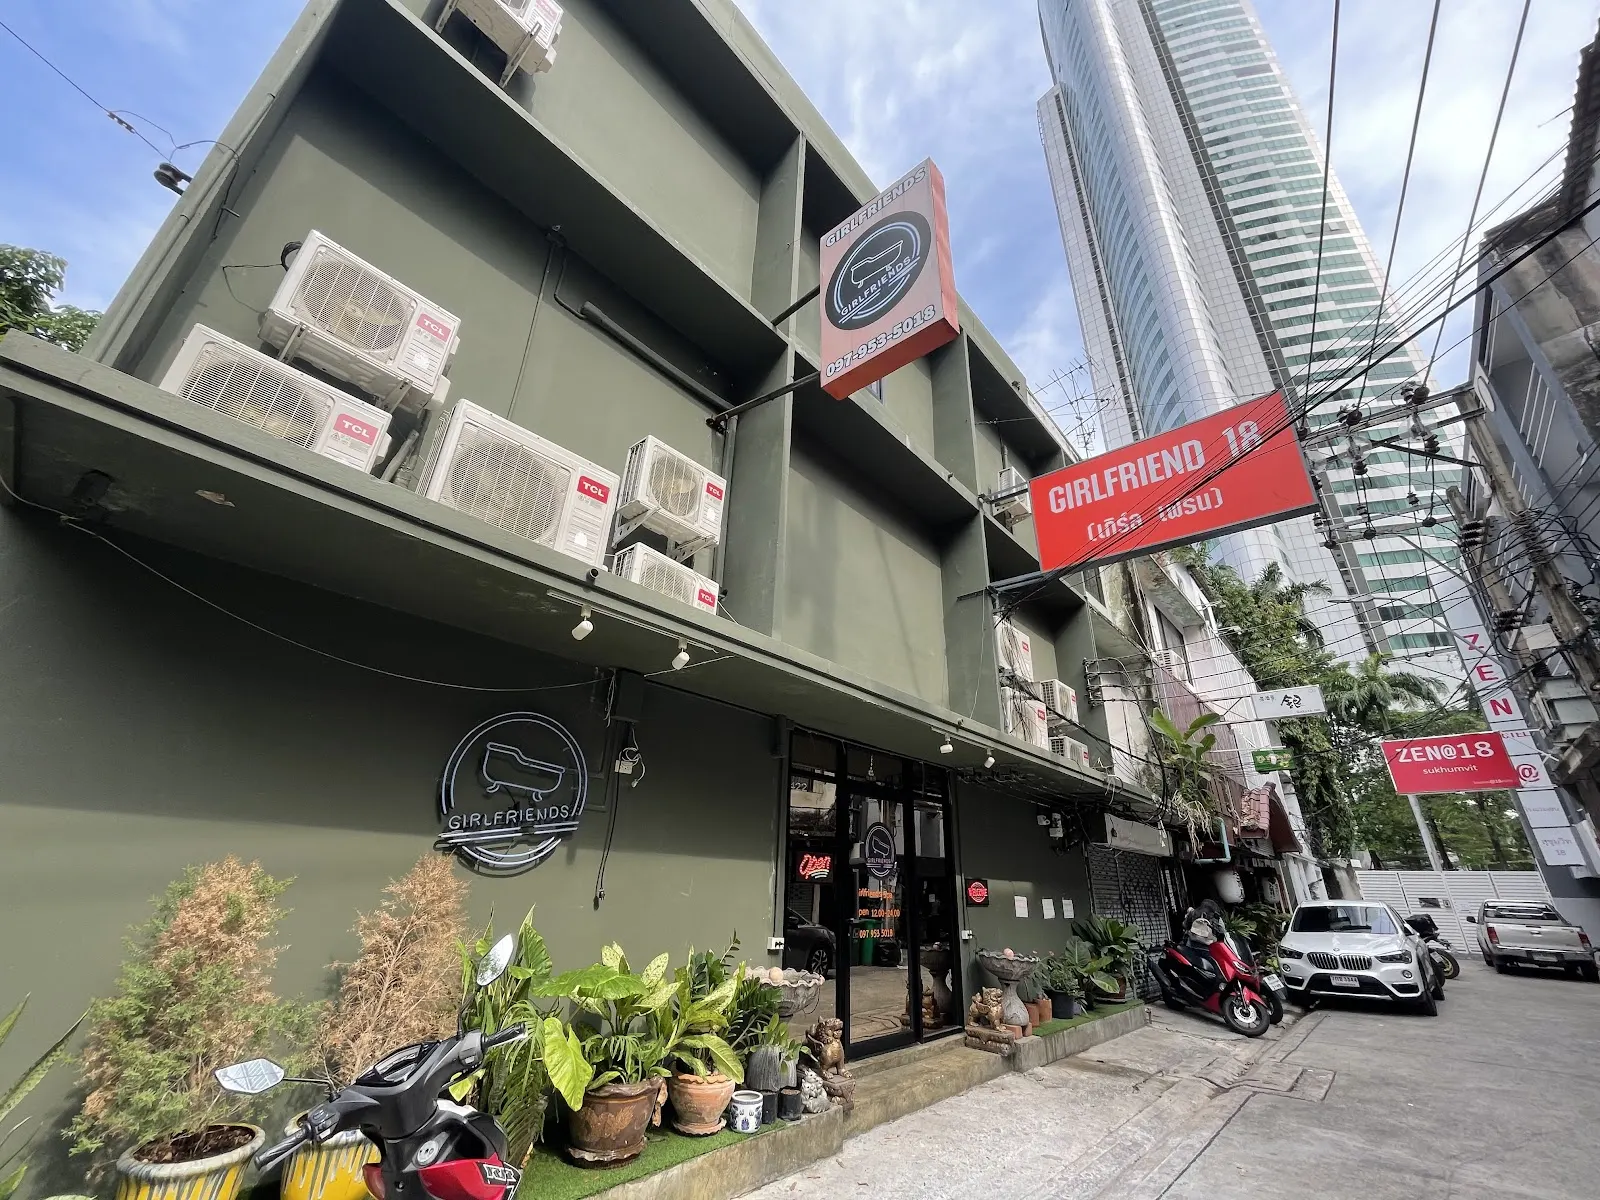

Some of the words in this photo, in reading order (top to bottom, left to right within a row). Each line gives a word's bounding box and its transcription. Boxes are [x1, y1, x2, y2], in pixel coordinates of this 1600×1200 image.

[825, 166, 927, 248] GIRLFRIENDS
[840, 256, 911, 316] GIRLFRIENDS
[423, 318, 445, 336] TCL
[825, 304, 936, 378] 097-953-5018
[342, 419, 370, 438] TCL
[1048, 439, 1206, 514] GIRLFRIEND
[1222, 420, 1263, 459] 18
[583, 481, 605, 498] TCL
[708, 486, 721, 496] TCL
[700, 592, 713, 603] TCL
[1461, 633, 1513, 716] ZEN
[1396, 741, 1495, 763] ZEN@18
[1423, 764, 1478, 775] sukhumvit
[448, 805, 570, 830] GIRLFRIENDS
[799, 854, 832, 879] Open
[858, 908, 870, 917] pen
[859, 929, 869, 938] 097
[870, 929, 880, 938] 953
[880, 928, 894, 937] 5018
